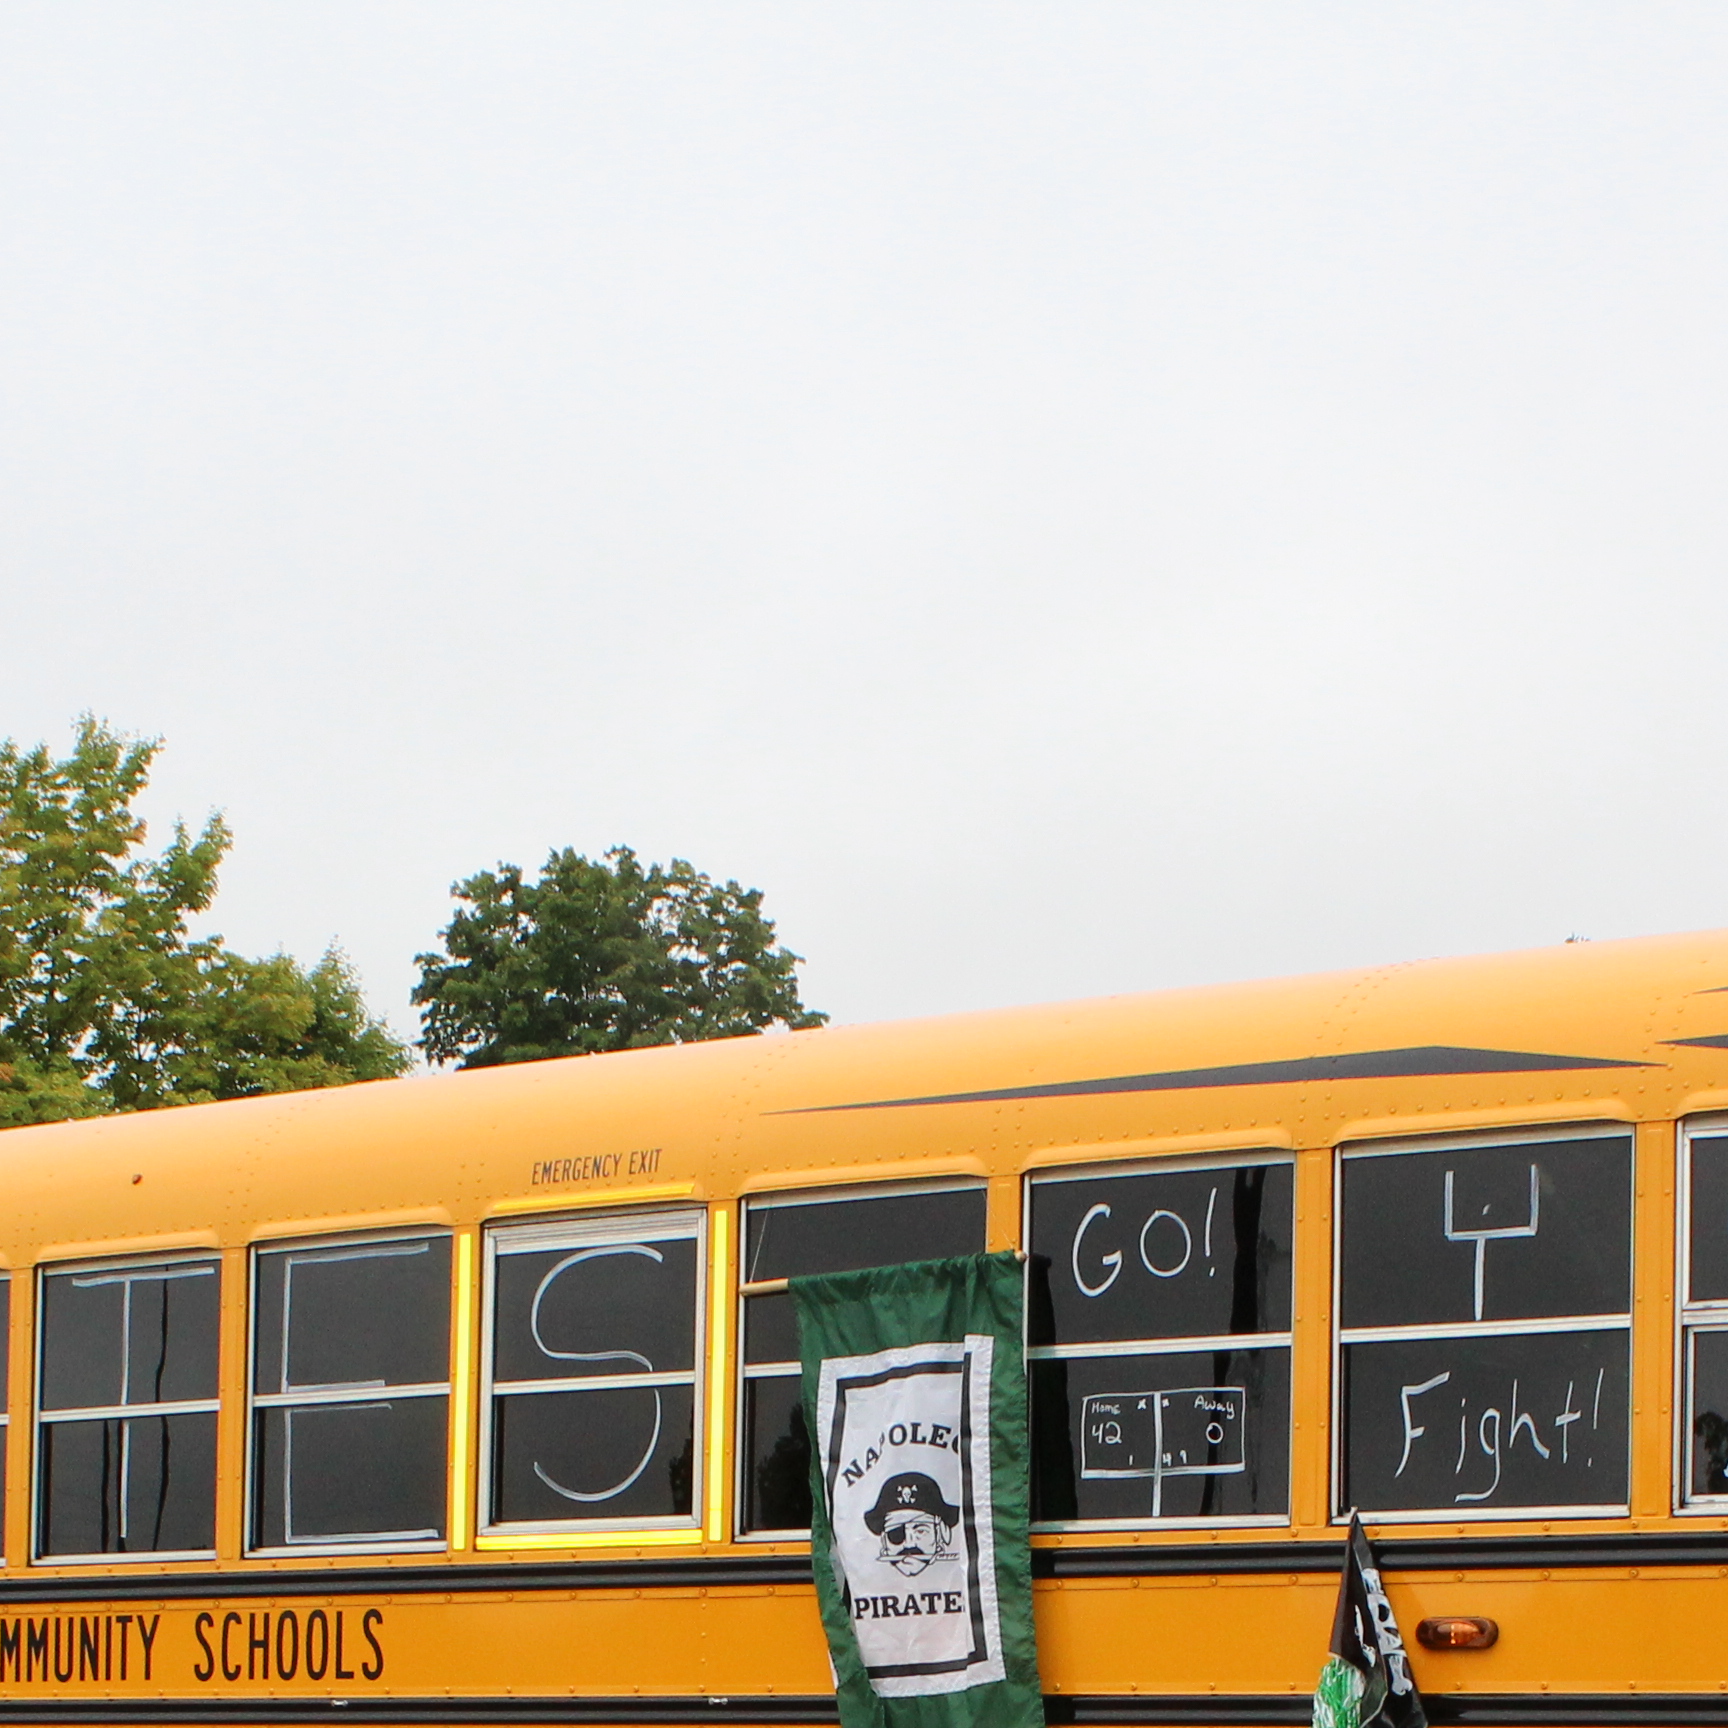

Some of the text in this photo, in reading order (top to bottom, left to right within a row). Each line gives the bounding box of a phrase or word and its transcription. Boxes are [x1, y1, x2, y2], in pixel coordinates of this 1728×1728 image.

[532, 1149, 663, 1186] EMERGENCY EXIT
[1072, 1187, 1217, 1297] GO!
[1091, 1401, 1122, 1415] Home
[1194, 1395, 1235, 1420] Away
[1091, 1421, 1123, 1444] 42
[1393, 1367, 1604, 1502] Fight!
[193, 1608, 386, 1682] SCHOOLS
